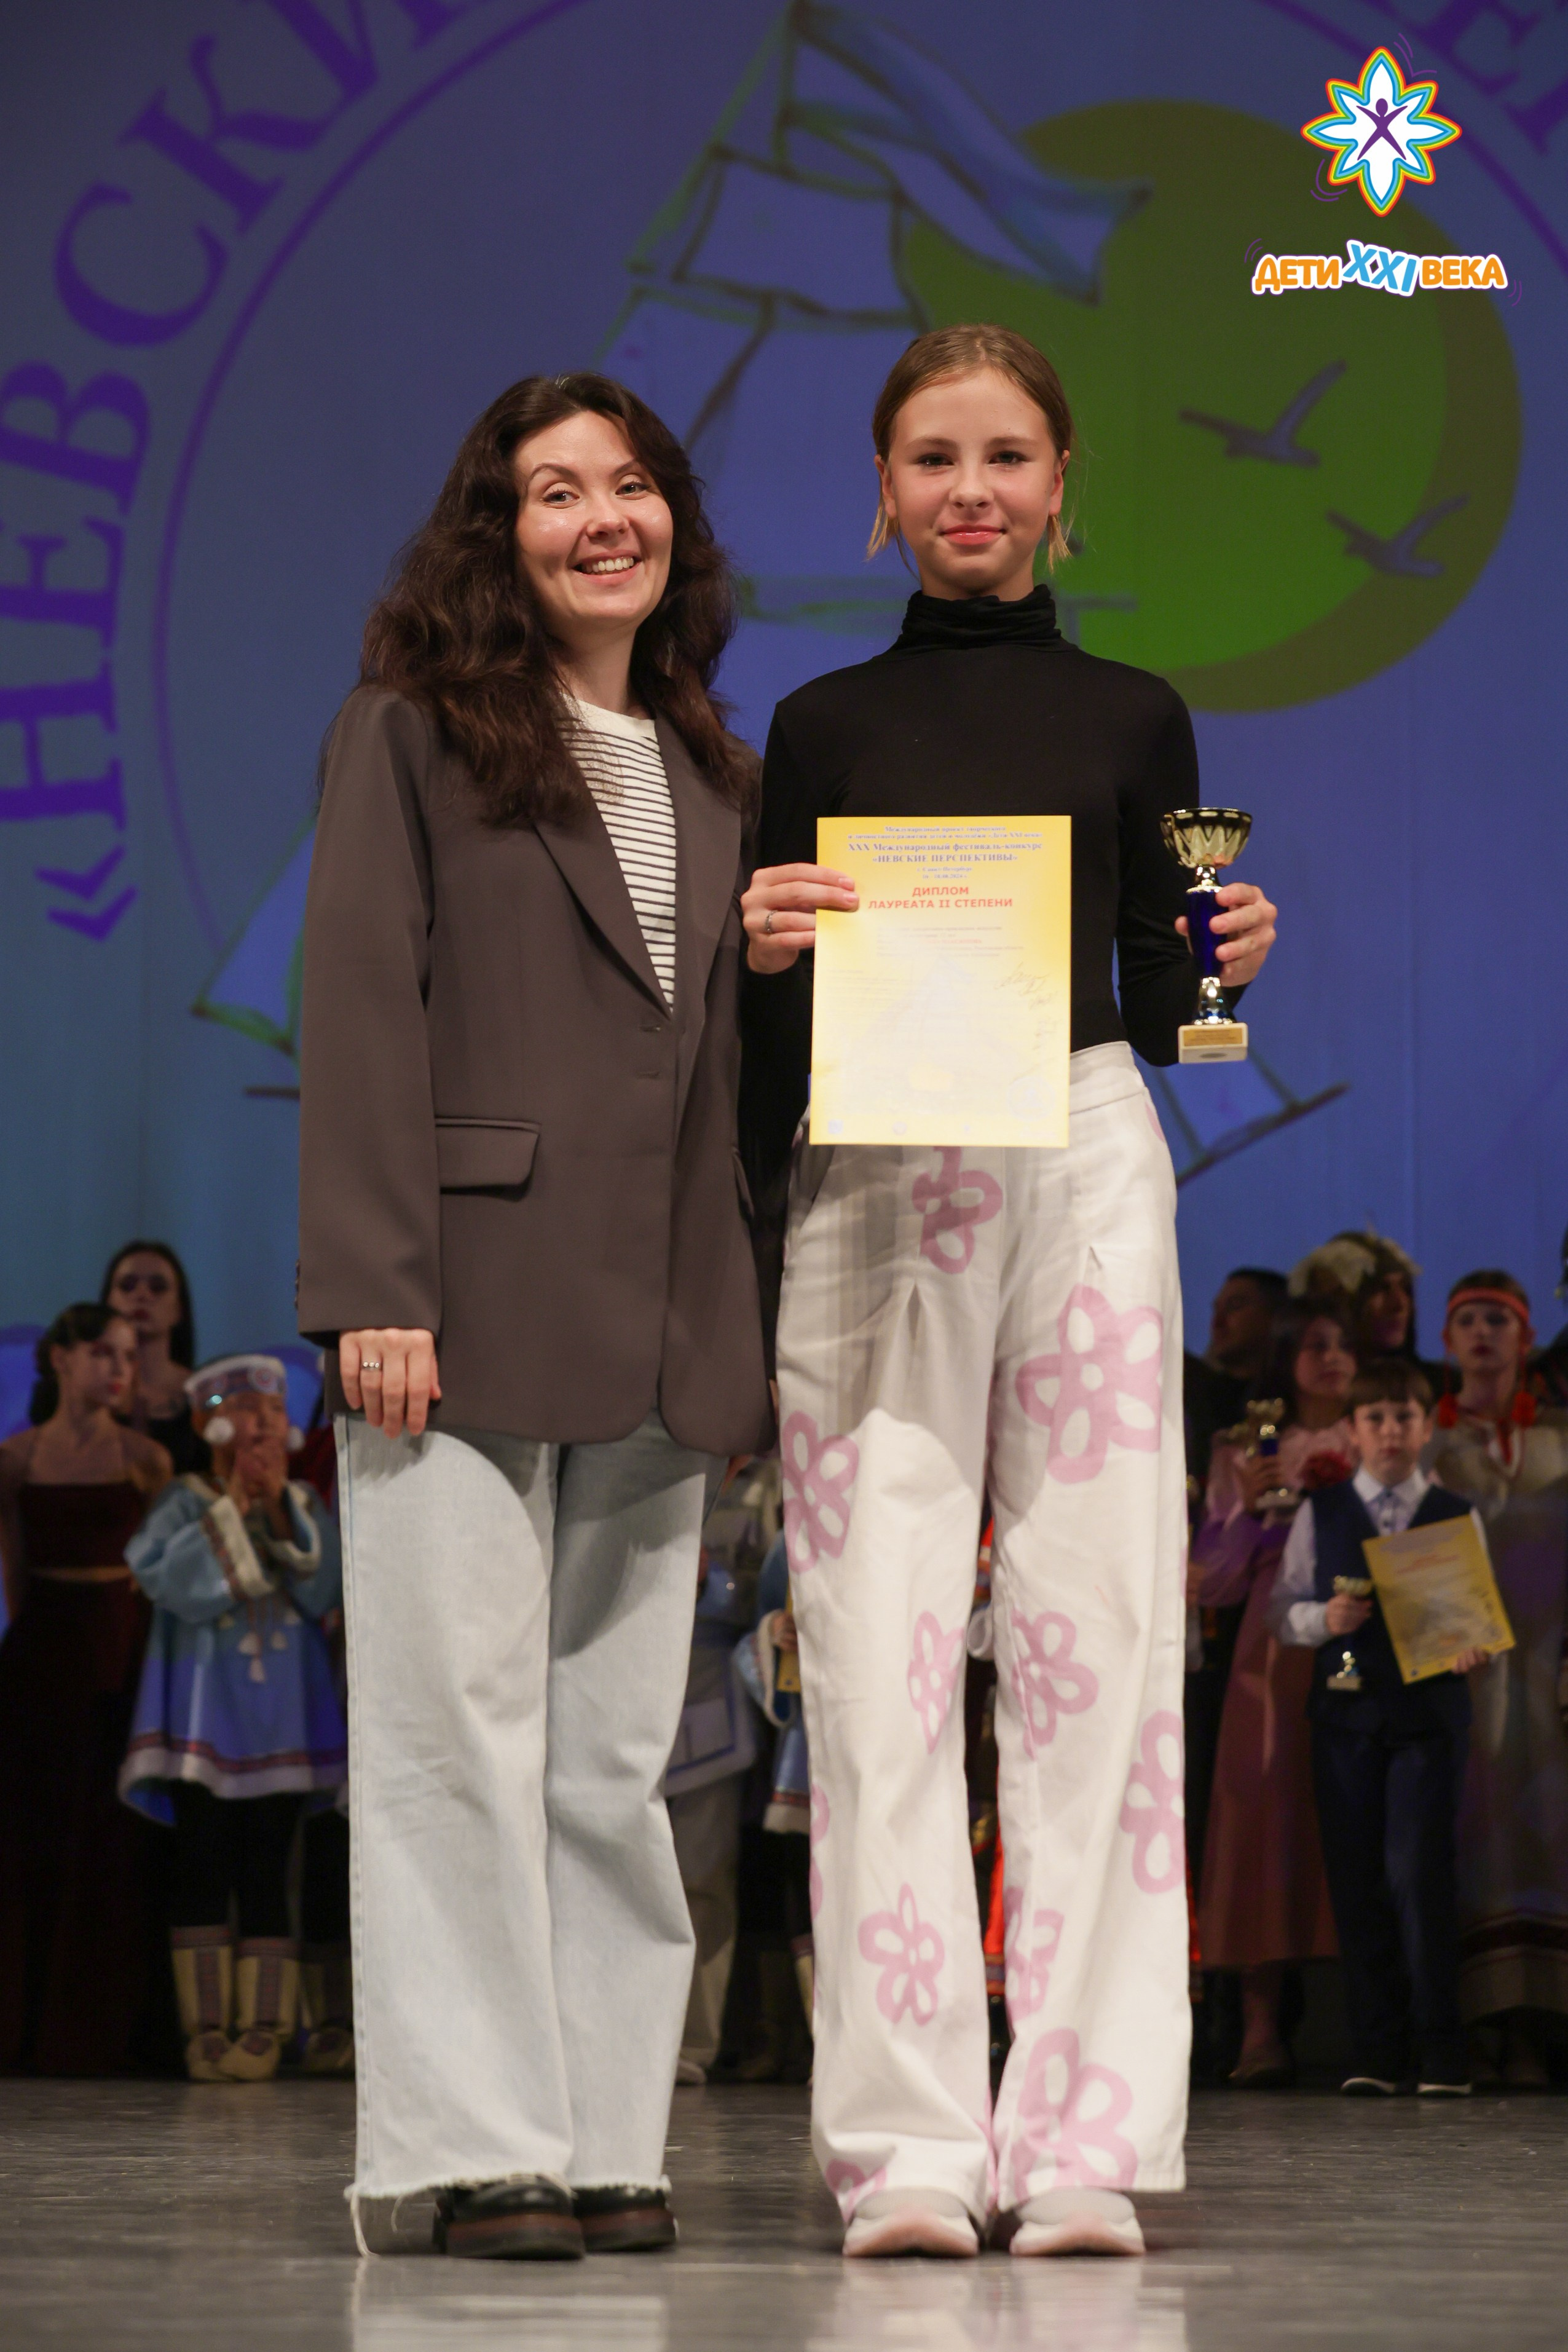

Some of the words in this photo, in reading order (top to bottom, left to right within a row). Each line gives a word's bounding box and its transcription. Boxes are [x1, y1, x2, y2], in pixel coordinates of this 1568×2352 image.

[873, 842, 950, 852] Международный
[953, 842, 1042, 851] фестиваль-конкурс
[931, 853, 1018, 862] ПЕРСПЕКТИВЫ»
[912, 886, 969, 897] ДИПЛОМ
[868, 899, 935, 909] ЛАУРЕАТА
[939, 899, 950, 908] II
[954, 898, 1013, 908] СТЕПЕНИ
